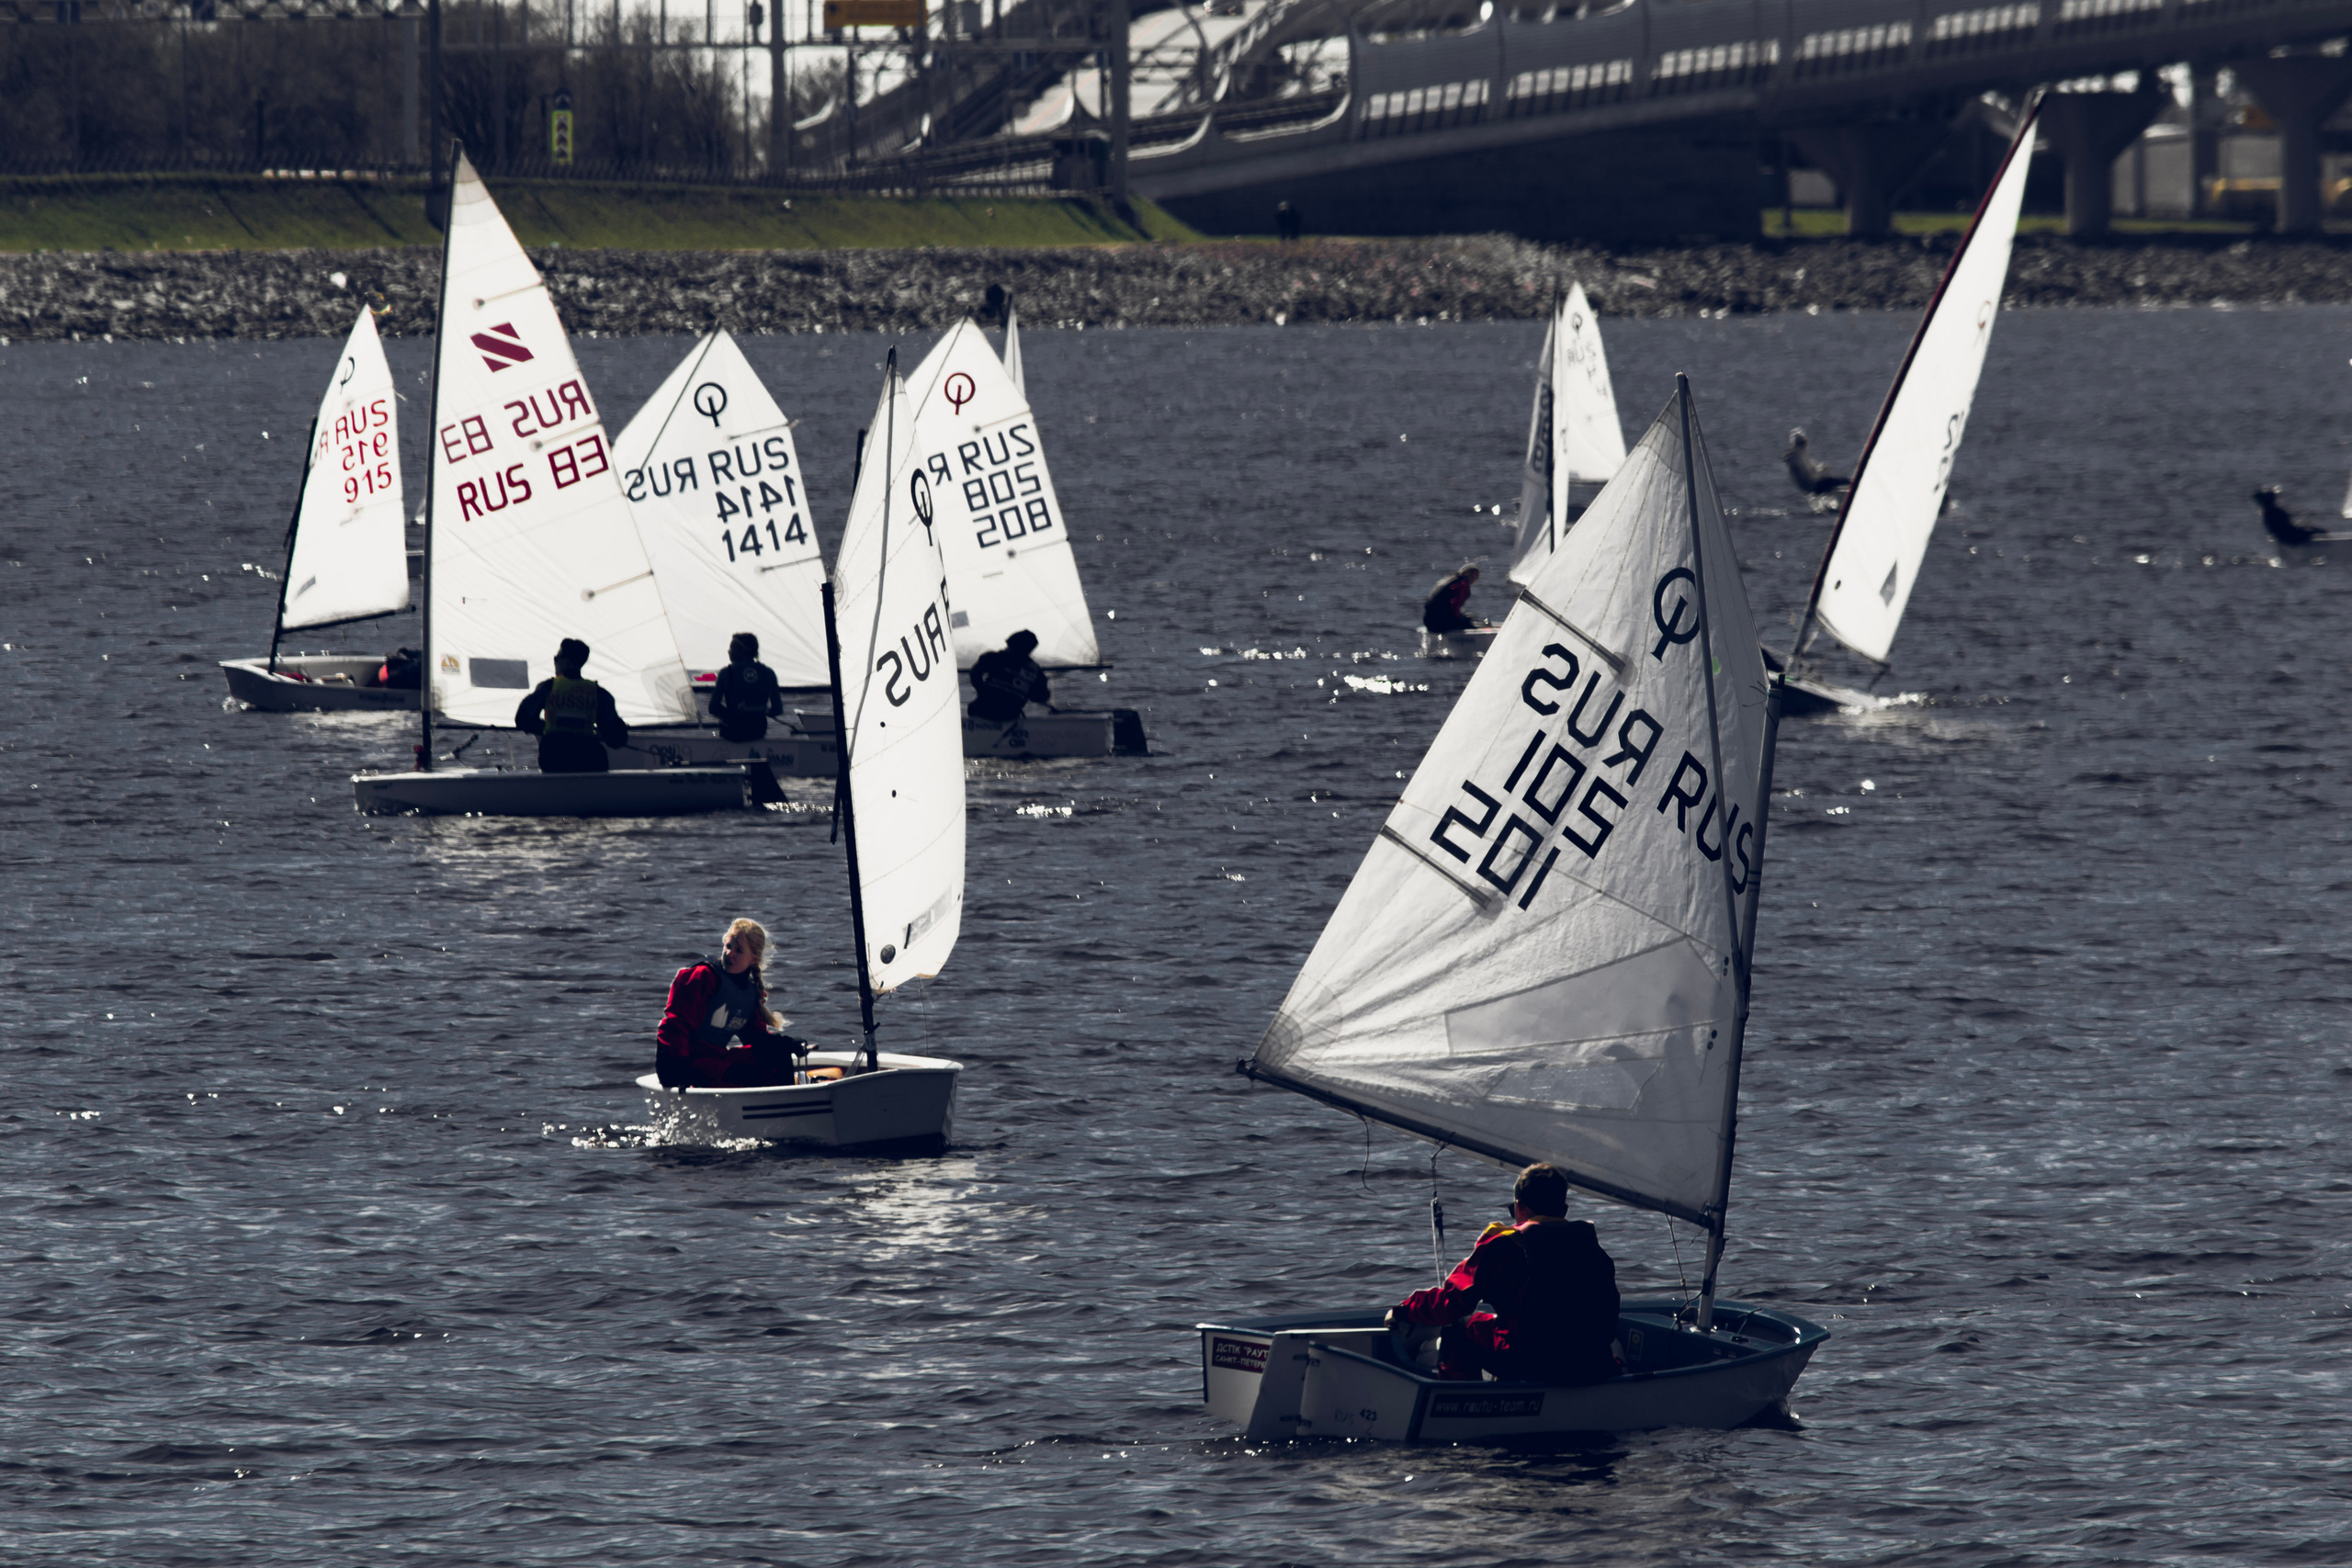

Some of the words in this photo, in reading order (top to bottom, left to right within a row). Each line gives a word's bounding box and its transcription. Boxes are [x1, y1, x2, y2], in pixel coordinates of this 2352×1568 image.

[335, 400, 389, 445] RUS
[707, 436, 789, 485] RUS
[958, 423, 1035, 475] RUS
[344, 462, 392, 503] 915
[457, 463, 532, 522] RUS
[548, 434, 609, 490] 83
[722, 512, 808, 562] 1414
[972, 497, 1052, 548] 208
[548, 694, 597, 710] RUSSIA
[1430, 779, 1561, 911] 201
[1657, 750, 1753, 896] RUS
[1216, 1343, 1240, 1354] ДСПК
[1360, 1408, 1377, 1421] 423
[1435, 1399, 1540, 1413] www.rautu-team.ru
